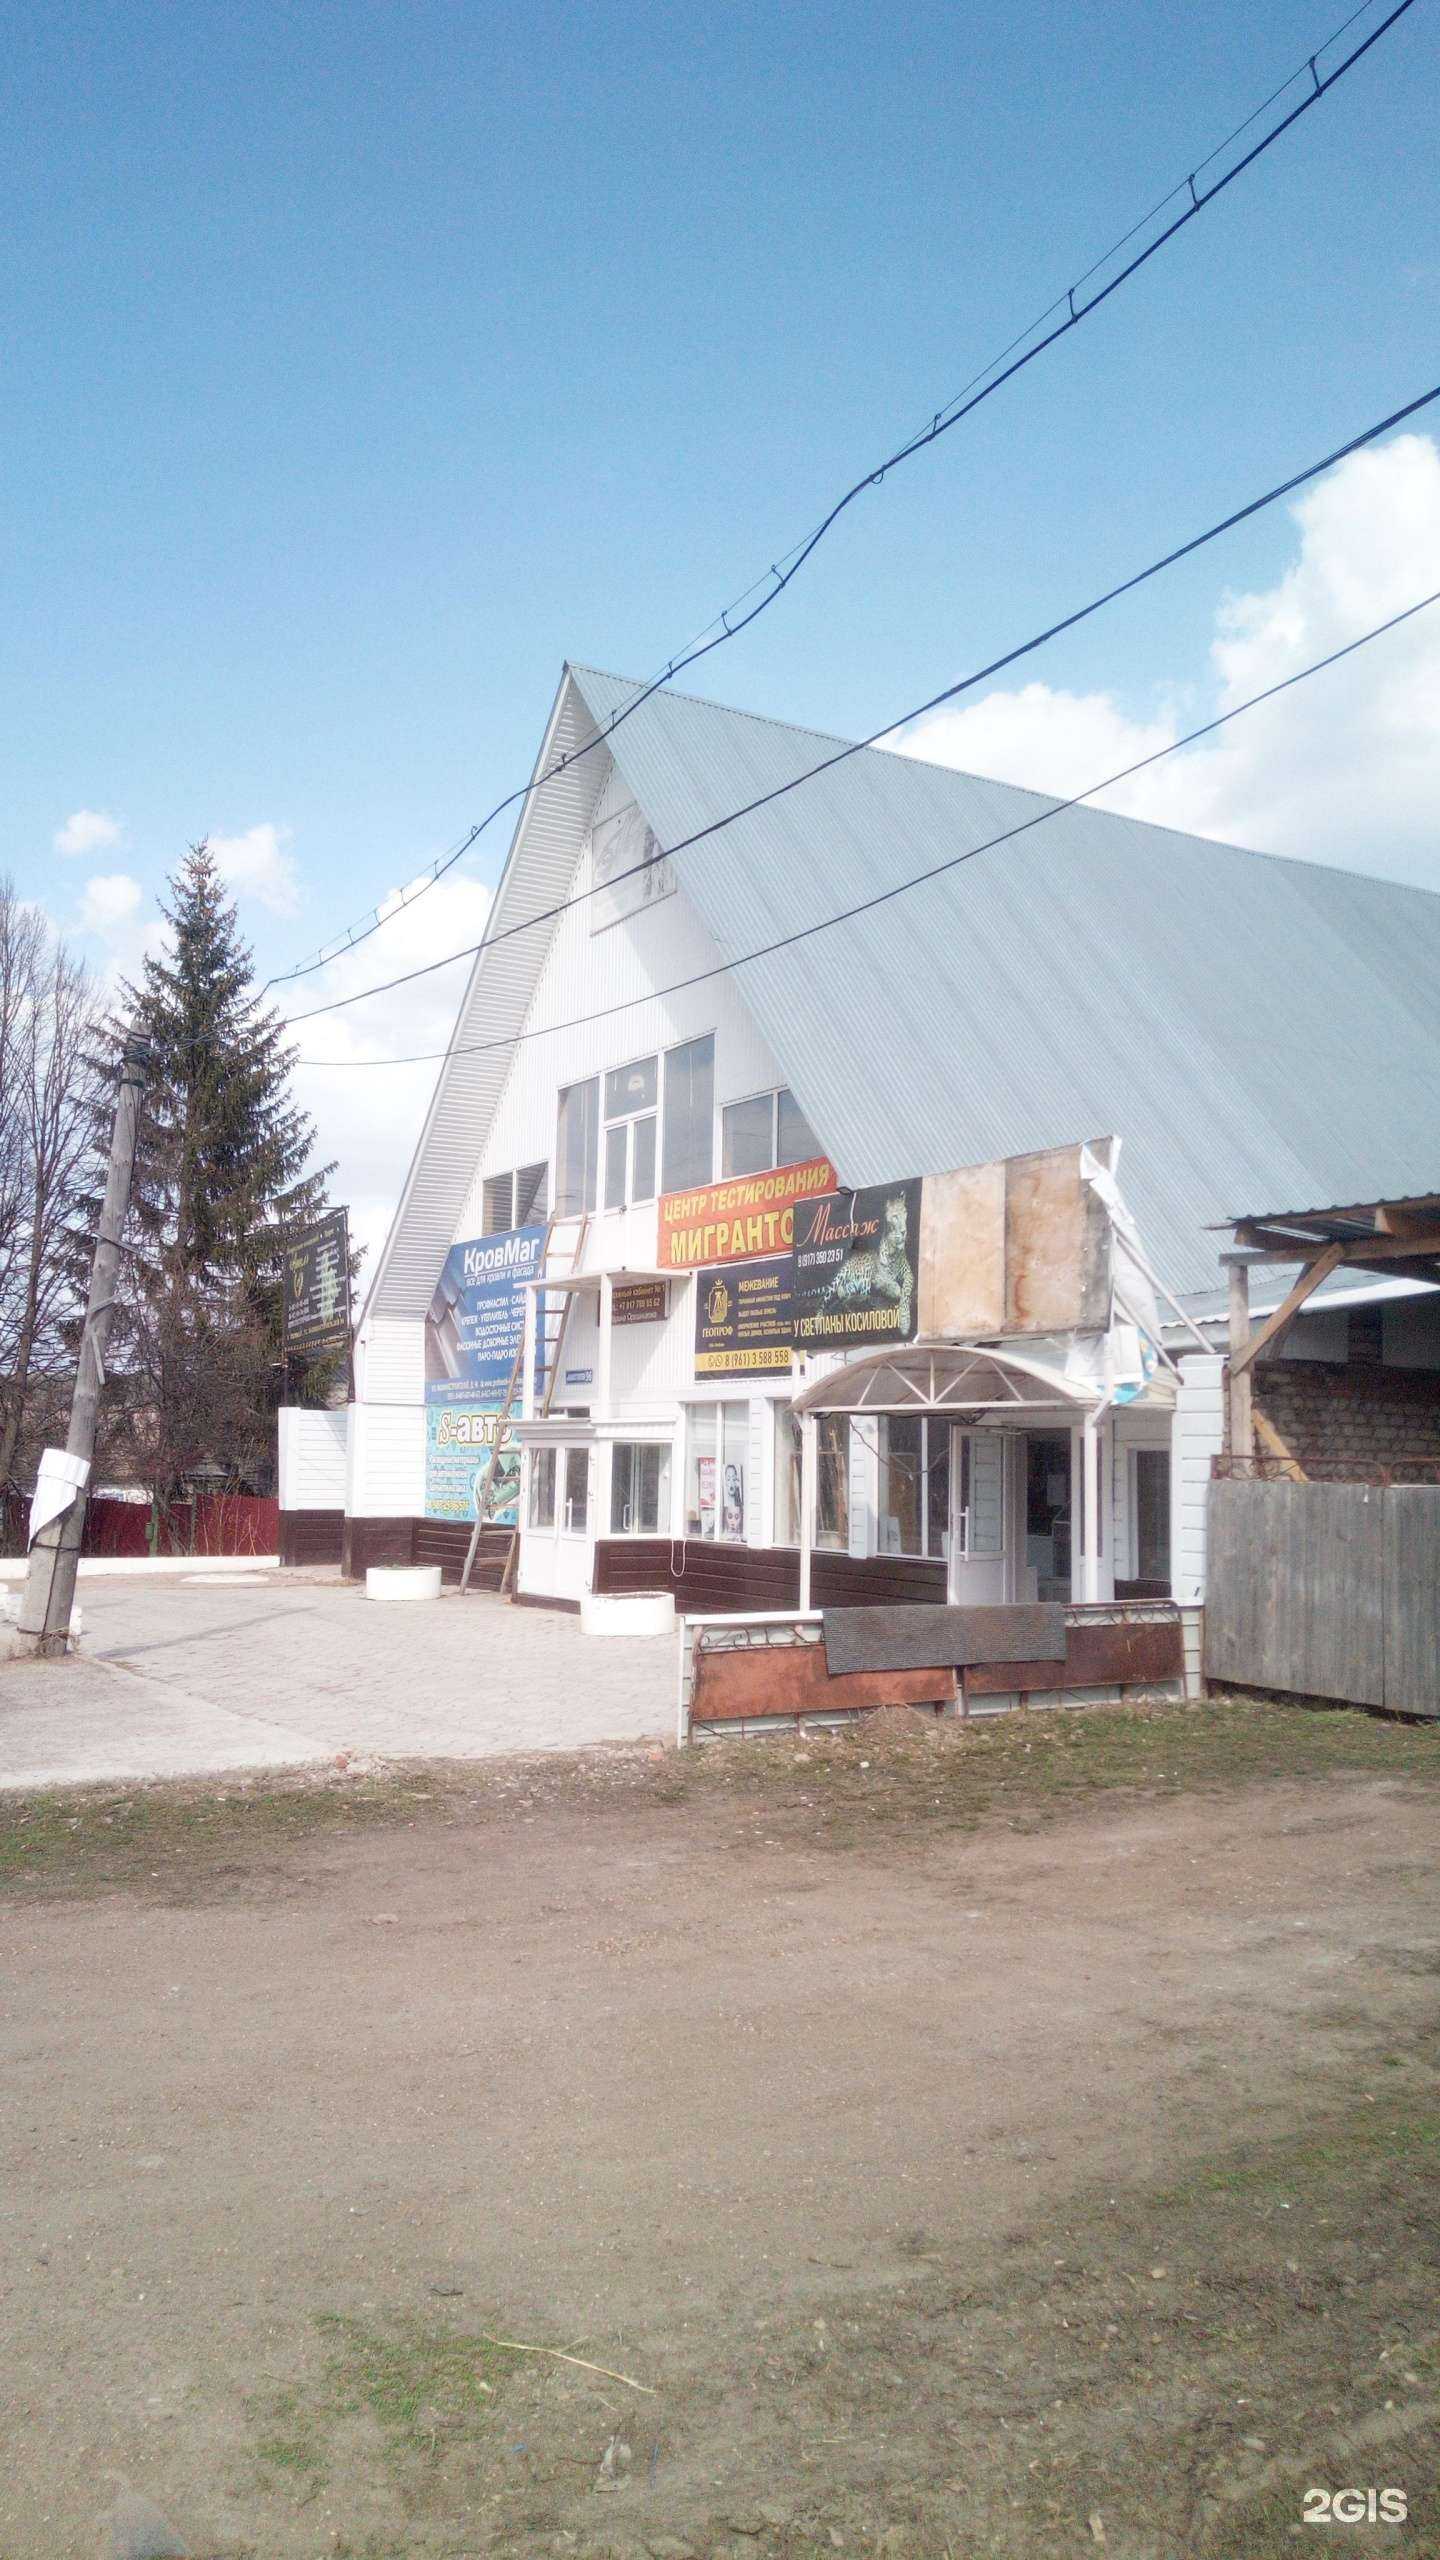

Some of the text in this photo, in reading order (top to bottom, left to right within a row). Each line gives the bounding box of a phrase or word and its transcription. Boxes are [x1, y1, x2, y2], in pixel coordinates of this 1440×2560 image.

[664, 1164, 829, 1223] ЦЕНТР ТЕСТИРОВАНИЯ
[671, 1208, 794, 1265] МИГРАНТО
[796, 1202, 880, 1246] Массаж
[464, 1238, 540, 1276] КровМаг
[738, 1276, 779, 1293] МЕЖЕВАНИЕ
[702, 1326, 733, 1338] ГЕОПРОФ
[793, 1319, 800, 1338] У
[800, 1315, 844, 1337] СВЕТЛАНЫ
[845, 1306, 900, 1333] КОСИЛОВОЙ
[725, 1350, 789, 1367] 8 (961) 3 588 558
